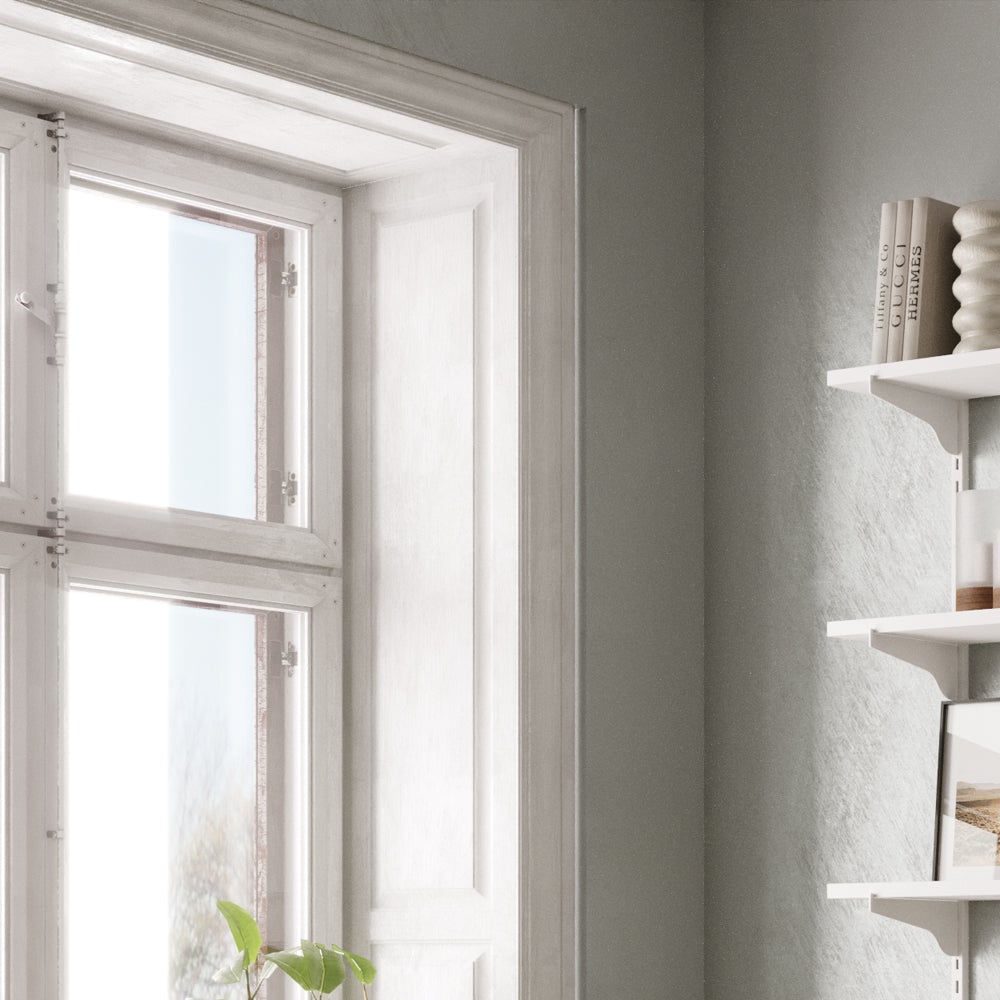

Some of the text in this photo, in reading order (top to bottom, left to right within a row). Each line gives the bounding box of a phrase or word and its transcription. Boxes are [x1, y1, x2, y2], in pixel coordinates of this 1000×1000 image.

[876, 244, 889, 329] Tiffany & Co
[891, 244, 907, 328] GUCCI
[908, 245, 922, 321] HERMES
